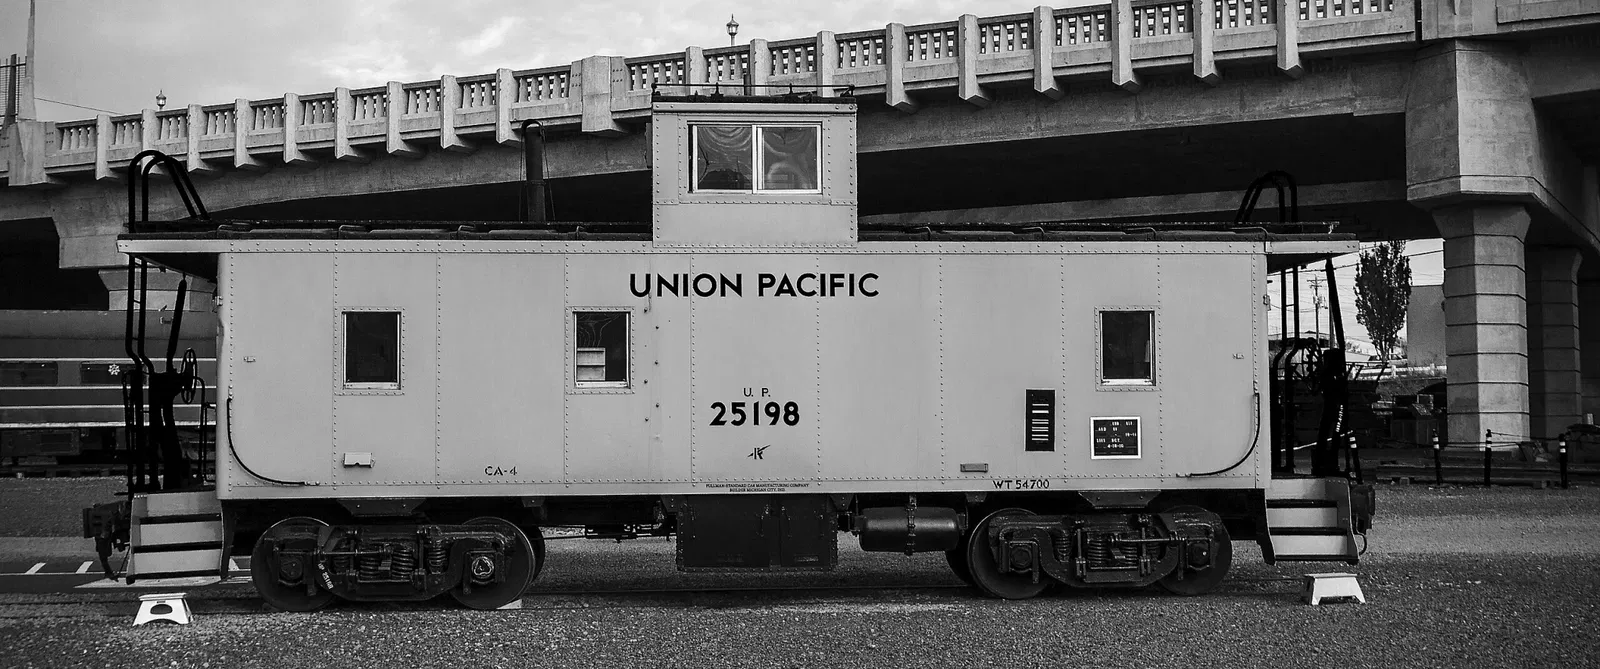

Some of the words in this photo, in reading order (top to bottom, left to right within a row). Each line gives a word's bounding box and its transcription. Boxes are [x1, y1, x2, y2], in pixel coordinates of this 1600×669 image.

[629, 273, 742, 298] UNION
[758, 273, 880, 298] PACIFIC
[743, 387, 754, 397] U.
[761, 387, 771, 397] P.
[709, 401, 800, 427] 25198
[484, 465, 518, 476] CA-4
[992, 479, 1013, 490] WT
[1015, 479, 1050, 490] 54700
